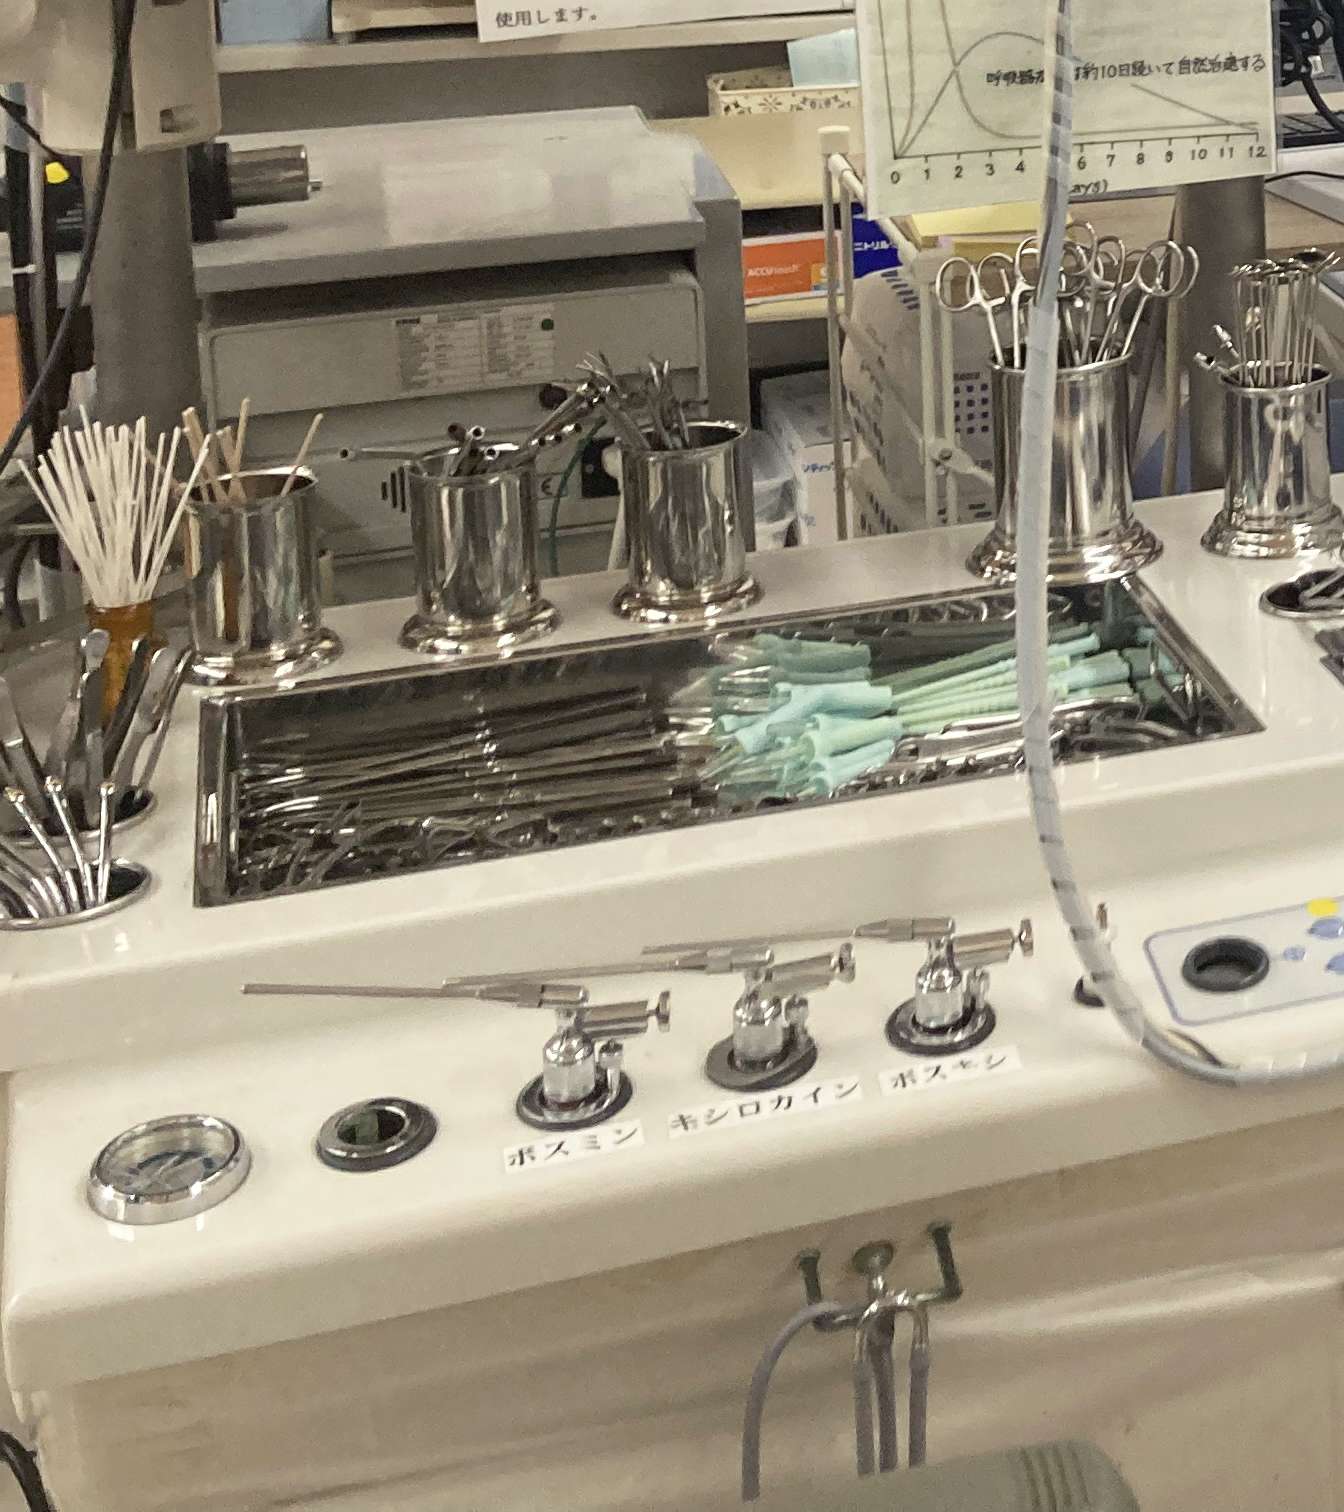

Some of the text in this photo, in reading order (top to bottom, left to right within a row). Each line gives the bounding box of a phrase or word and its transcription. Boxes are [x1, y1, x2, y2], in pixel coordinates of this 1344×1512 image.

[495, 6, 598, 29] 使用します。
[890, 145, 1267, 184] 0 1 2 3 4 6 7 8 9 10 11 12
[672, 1082, 860, 1132] キシロカイン
[507, 1127, 639, 1167] ボスミン
